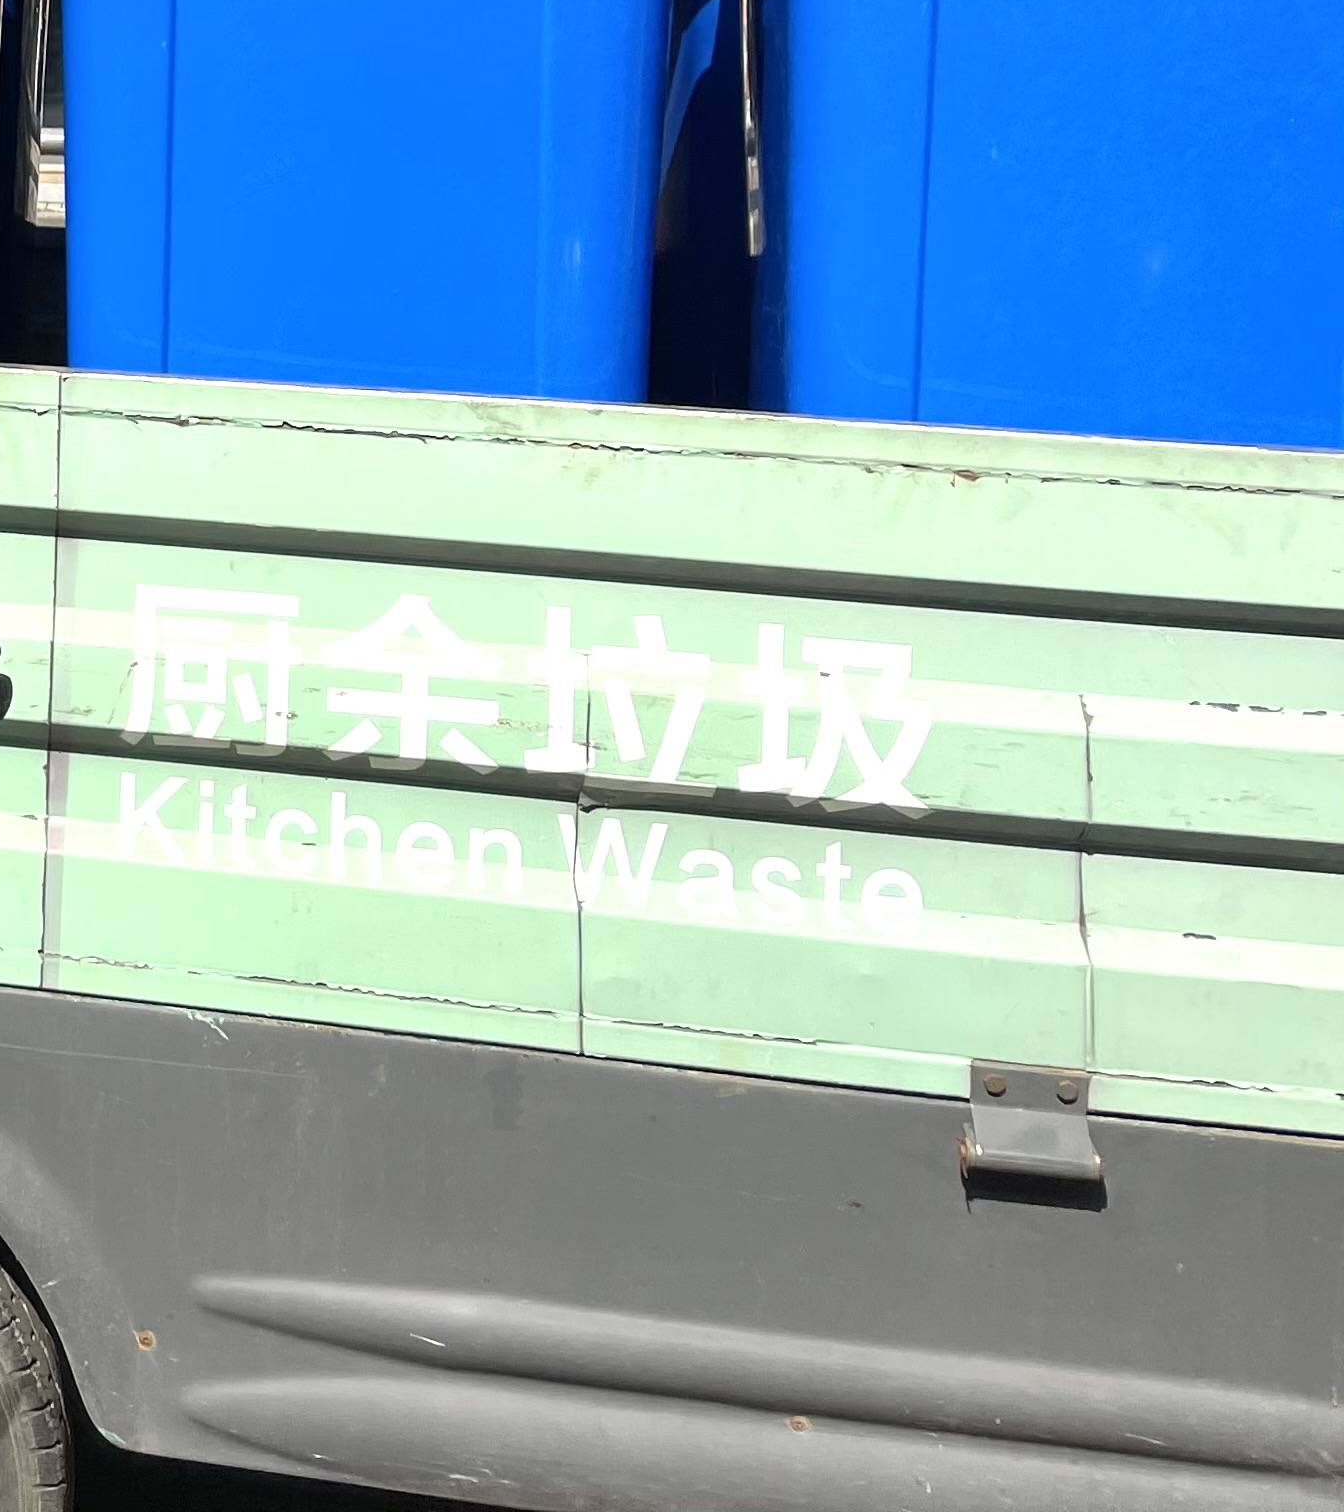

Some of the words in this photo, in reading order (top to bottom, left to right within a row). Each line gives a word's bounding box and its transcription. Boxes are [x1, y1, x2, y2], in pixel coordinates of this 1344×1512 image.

[120, 584, 932, 818] 厨余垃圾
[117, 772, 526, 892] Kitchen
[557, 813, 927, 936] Waste
